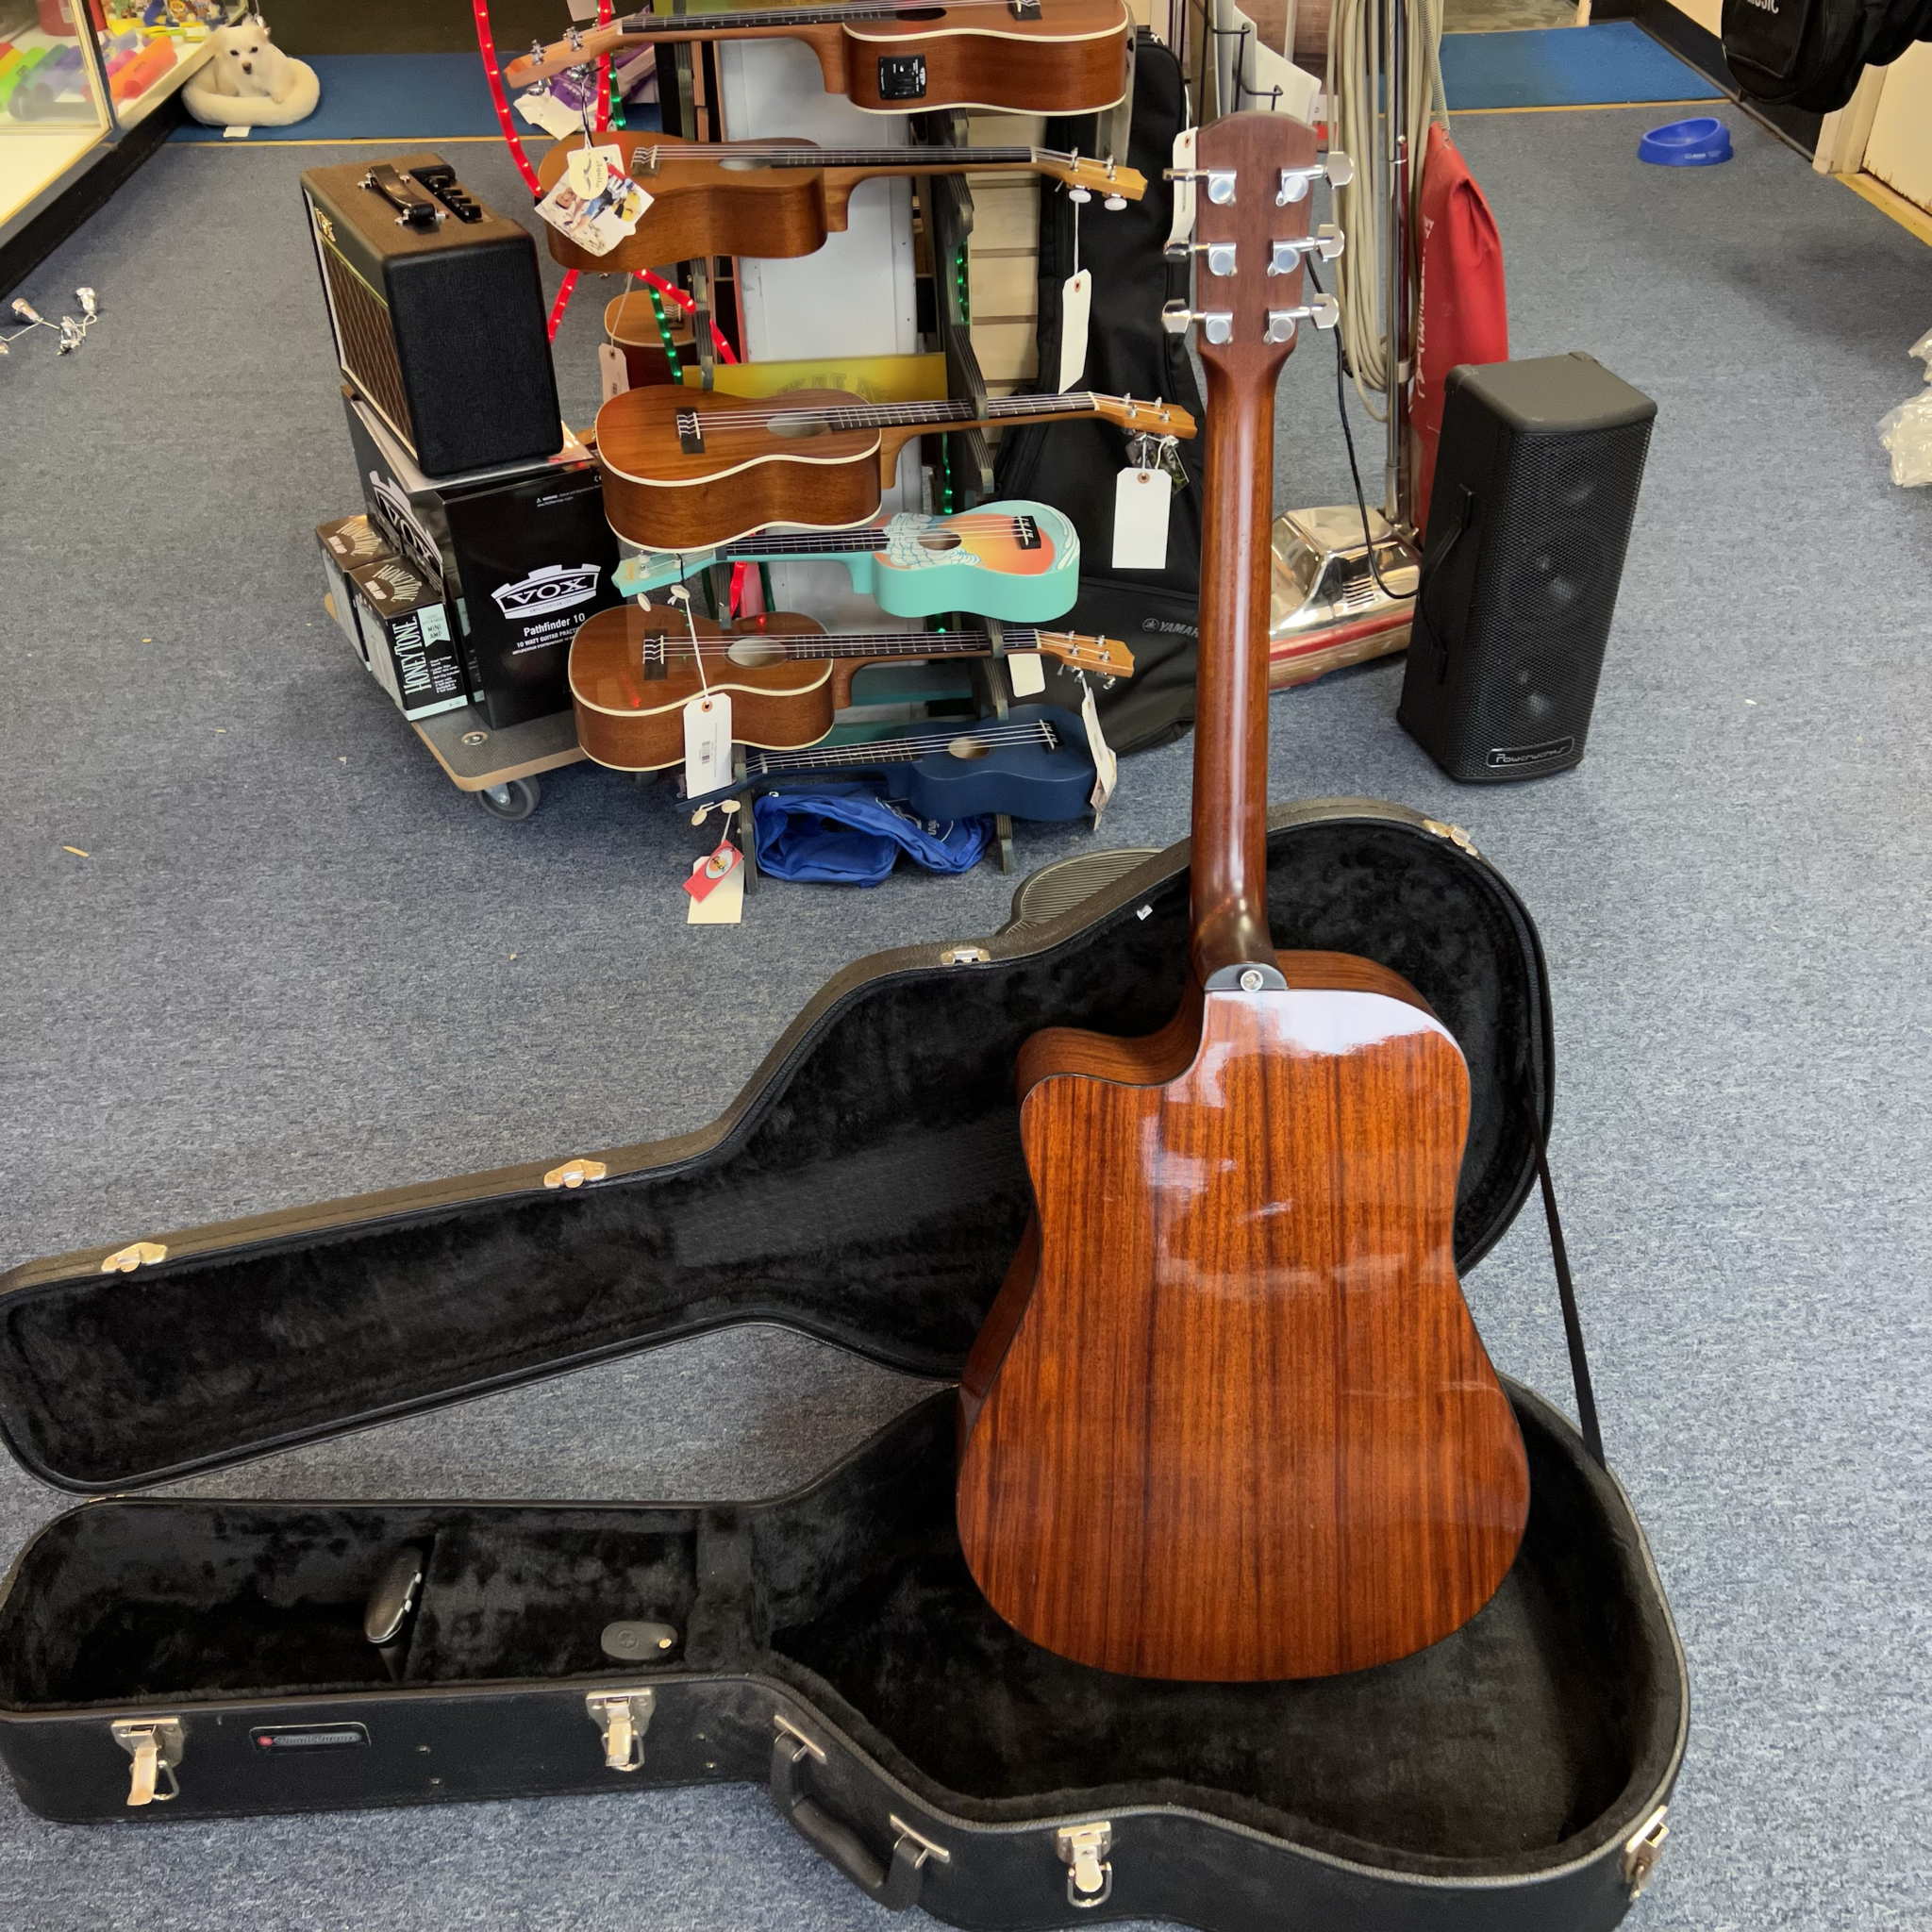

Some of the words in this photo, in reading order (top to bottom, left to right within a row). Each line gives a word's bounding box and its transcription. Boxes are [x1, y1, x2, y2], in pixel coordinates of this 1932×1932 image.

[507, 576, 588, 604] VOX
[524, 618, 570, 637] Pathfinder
[573, 613, 586, 624] 10
[1159, 621, 1200, 638] YAMAH
